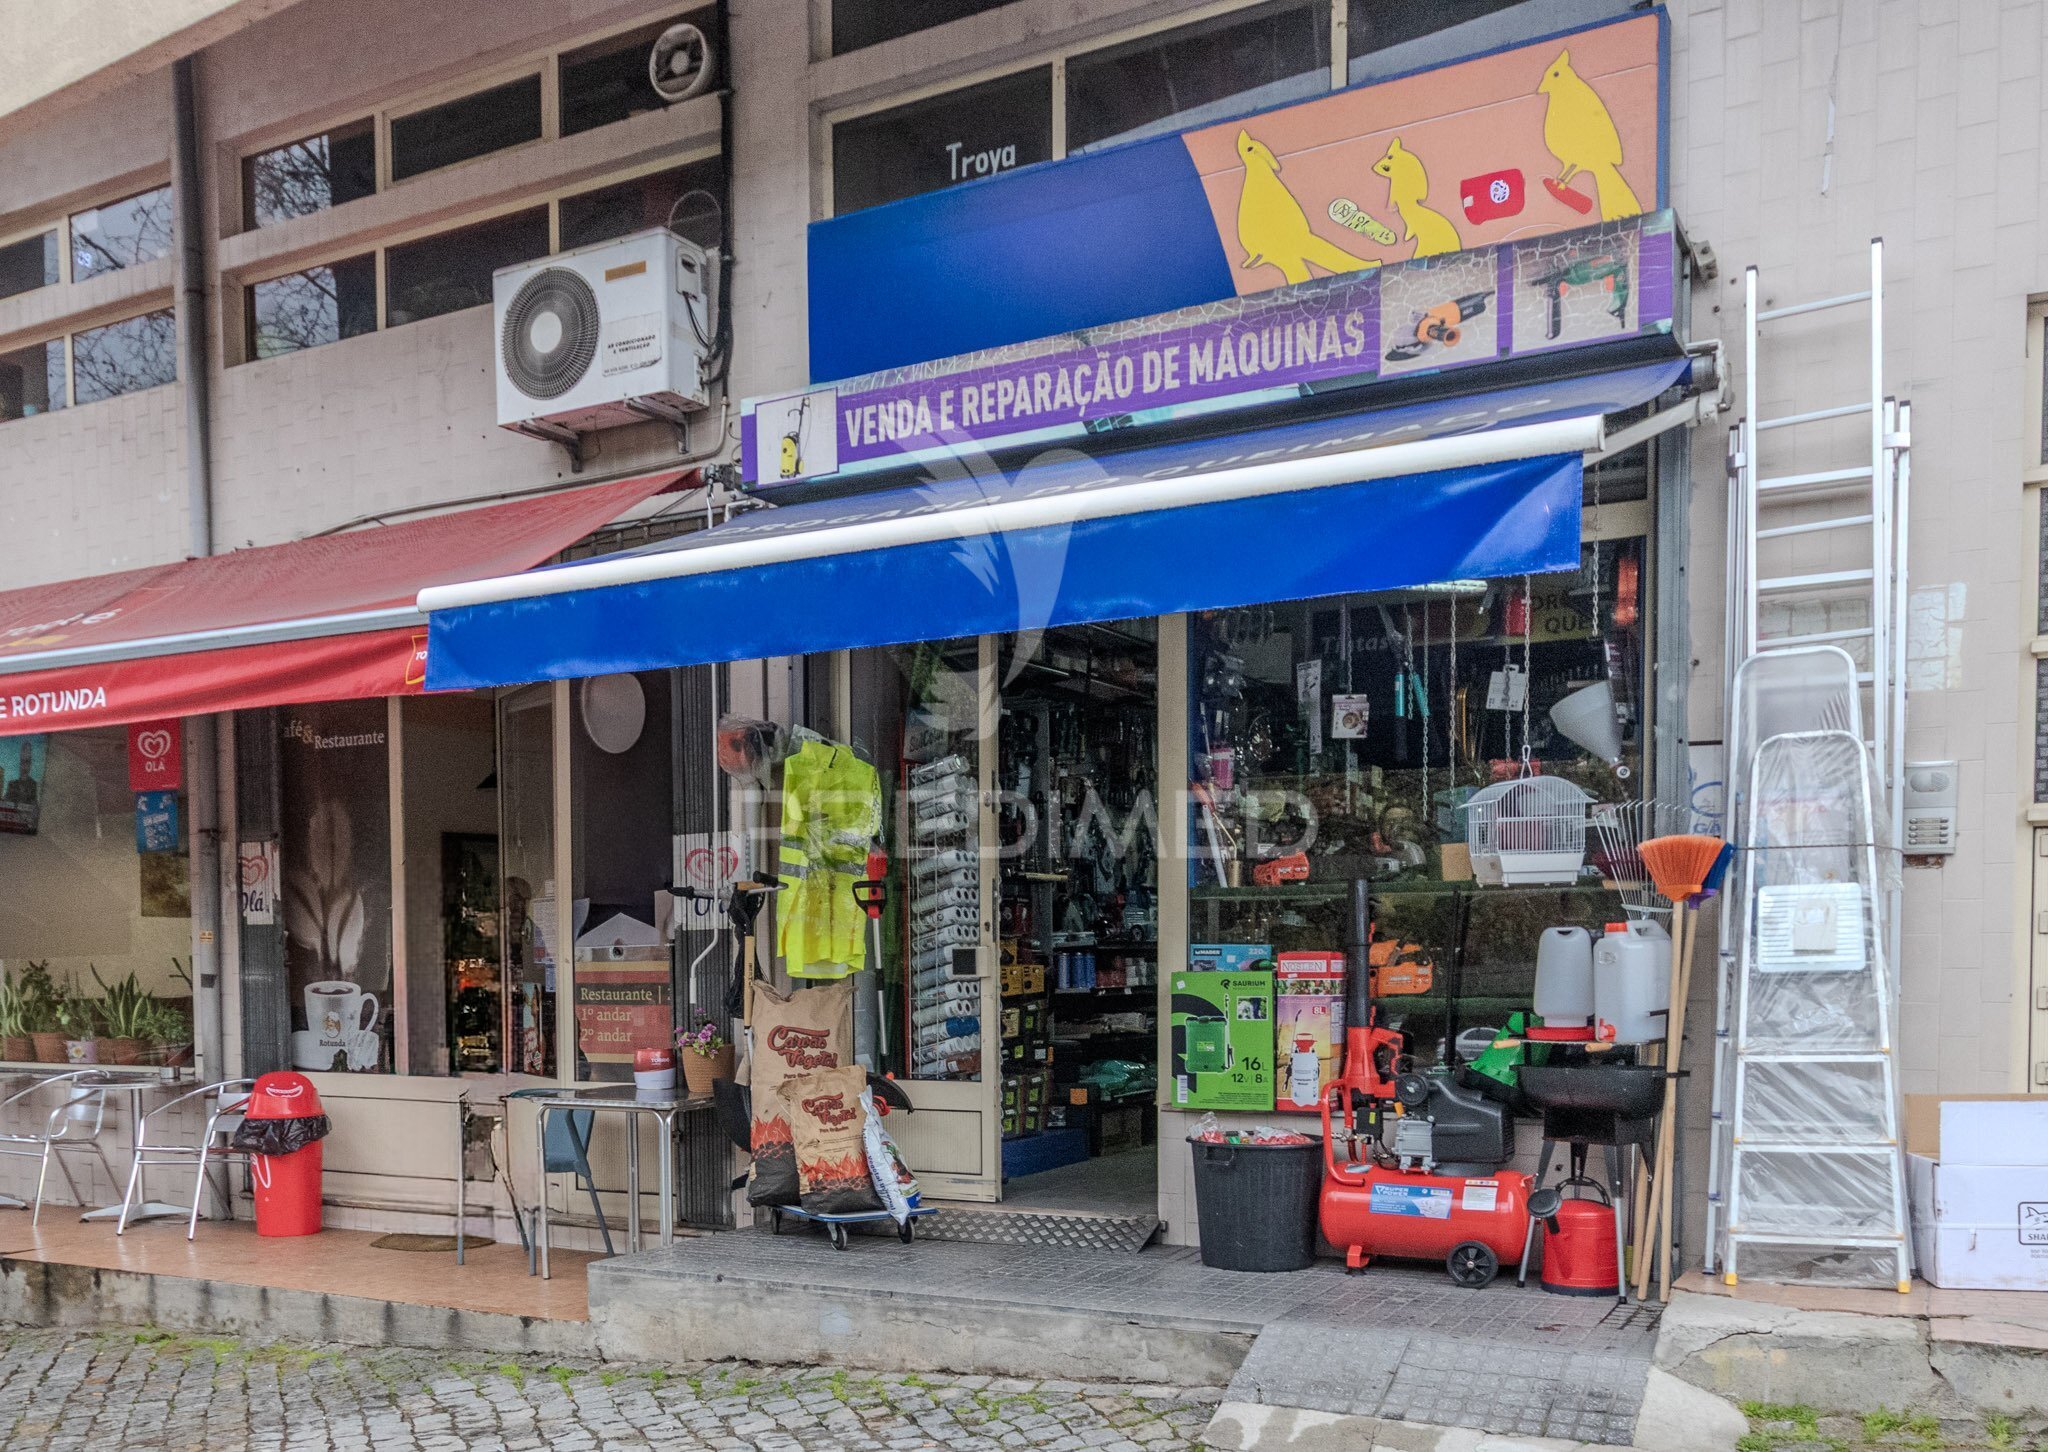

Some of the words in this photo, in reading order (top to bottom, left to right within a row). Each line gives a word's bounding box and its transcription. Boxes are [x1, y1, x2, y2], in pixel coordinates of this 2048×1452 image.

[946, 141, 1016, 180] Troya
[845, 395, 934, 448] VENDA
[940, 390, 955, 431] E
[962, 350, 1134, 427] REPARAÇÃO
[1142, 345, 1181, 394] DE
[1189, 311, 1365, 386] MÁQUINAS
[704, 495, 1002, 538] DROGARIA
[1022, 477, 1120, 499] DO
[12, 686, 107, 717] ROTUNDA
[314, 731, 386, 749] Restaurante
[580, 987, 653, 1001] Restaurante
[596, 1007, 632, 1022] andar
[597, 1026, 633, 1042] andar
[2028, 1233, 2048, 1241] SHA
